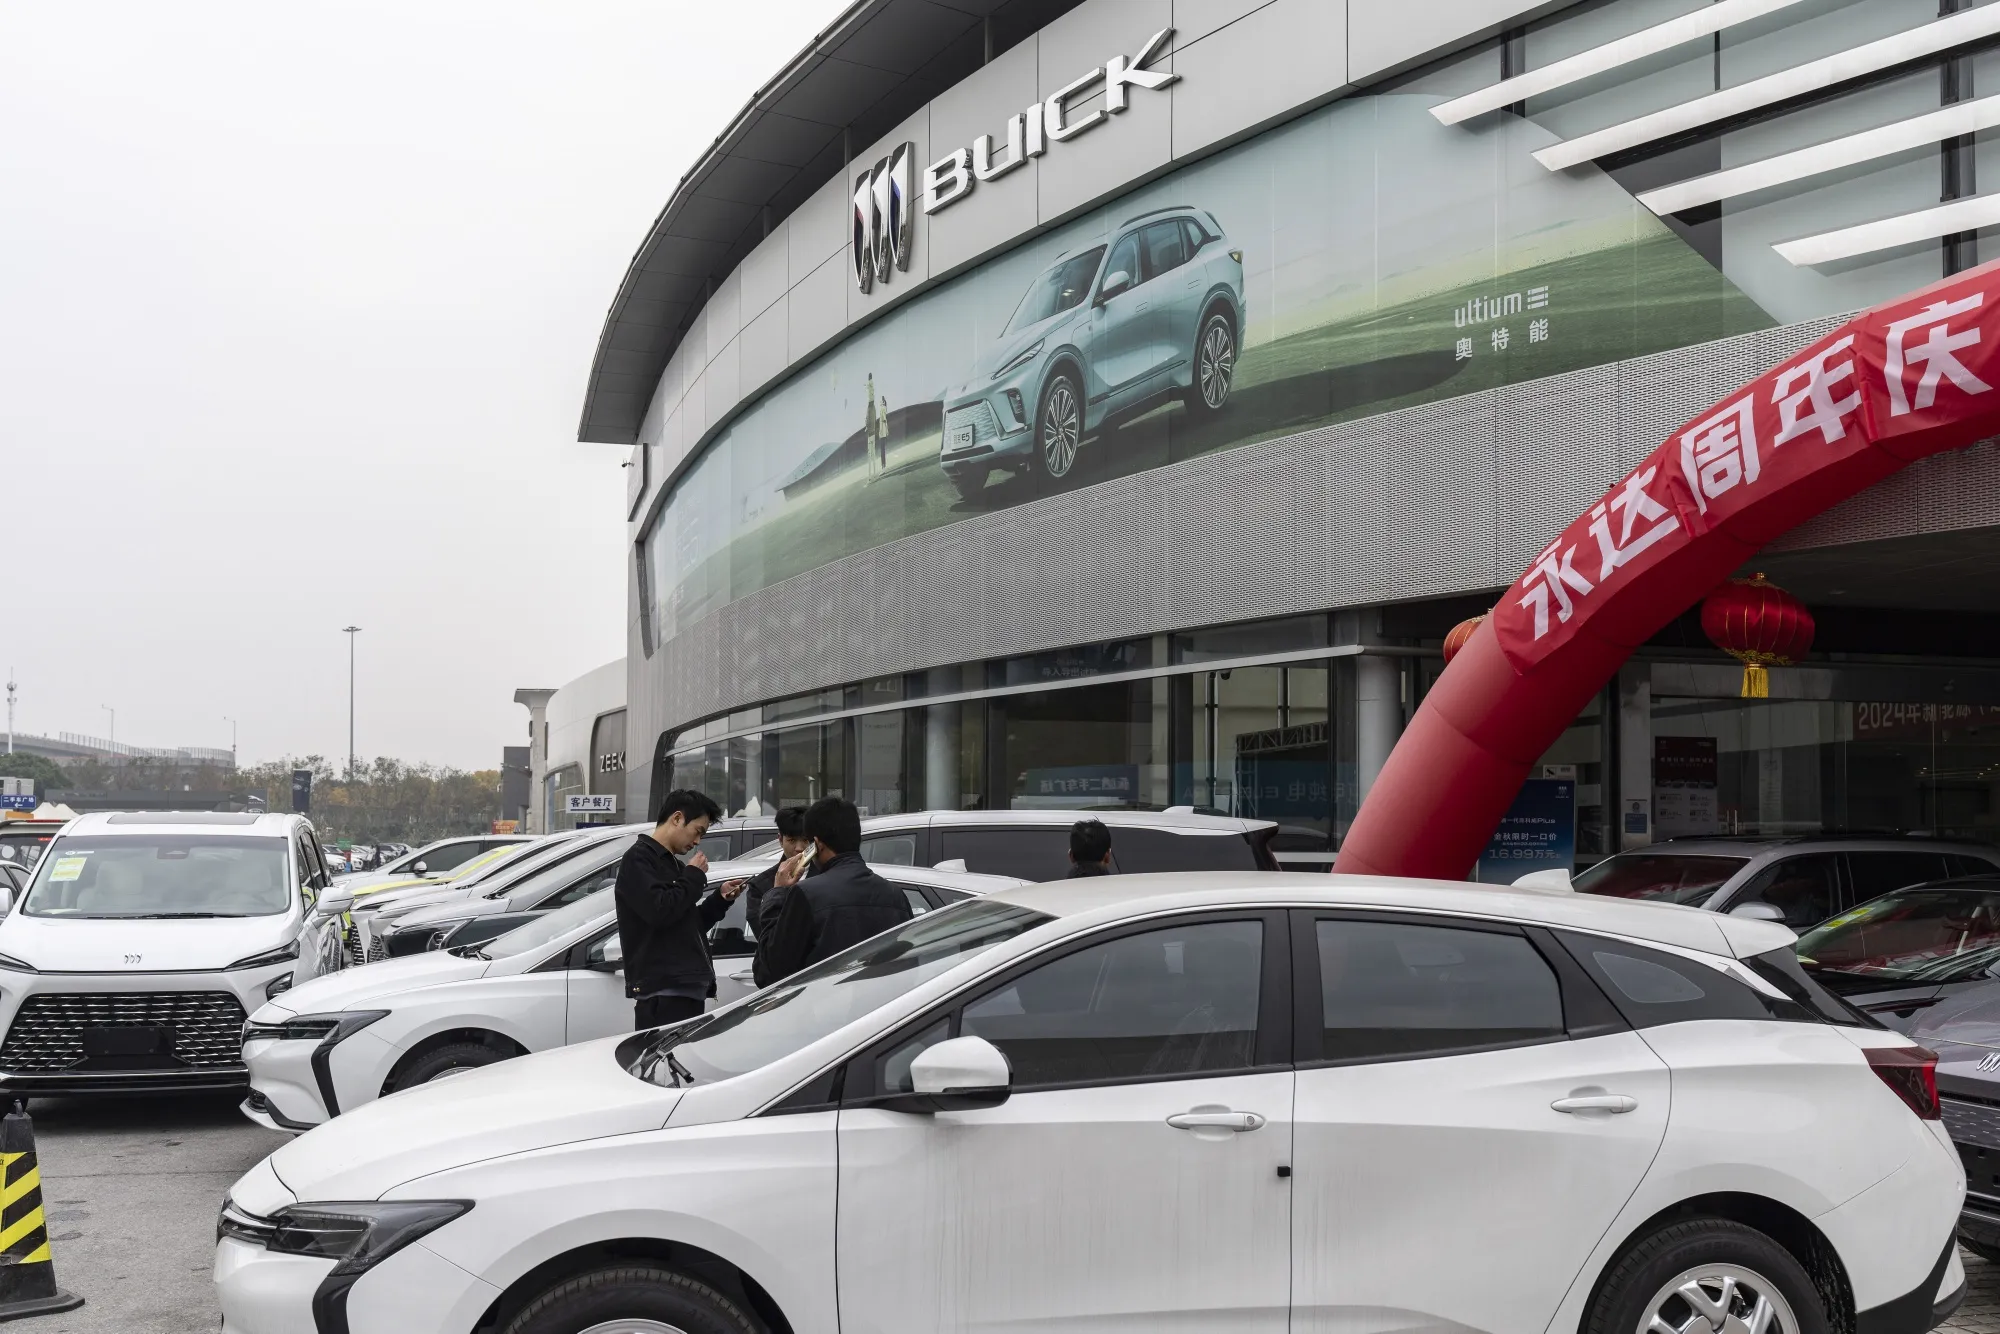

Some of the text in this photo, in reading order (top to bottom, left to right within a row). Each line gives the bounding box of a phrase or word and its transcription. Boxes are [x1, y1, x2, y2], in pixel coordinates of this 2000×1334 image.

[923, 27, 1183, 216] BUICK
[1454, 292, 1522, 328] ultium
[1455, 318, 1549, 361] 奥特能
[1516, 291, 1994, 641] 永达周年庆
[600, 752, 626, 773] ZEEK
[570, 797, 613, 807] 客户餐厅
[1493, 832, 1557, 841] 金秋限时一口价
